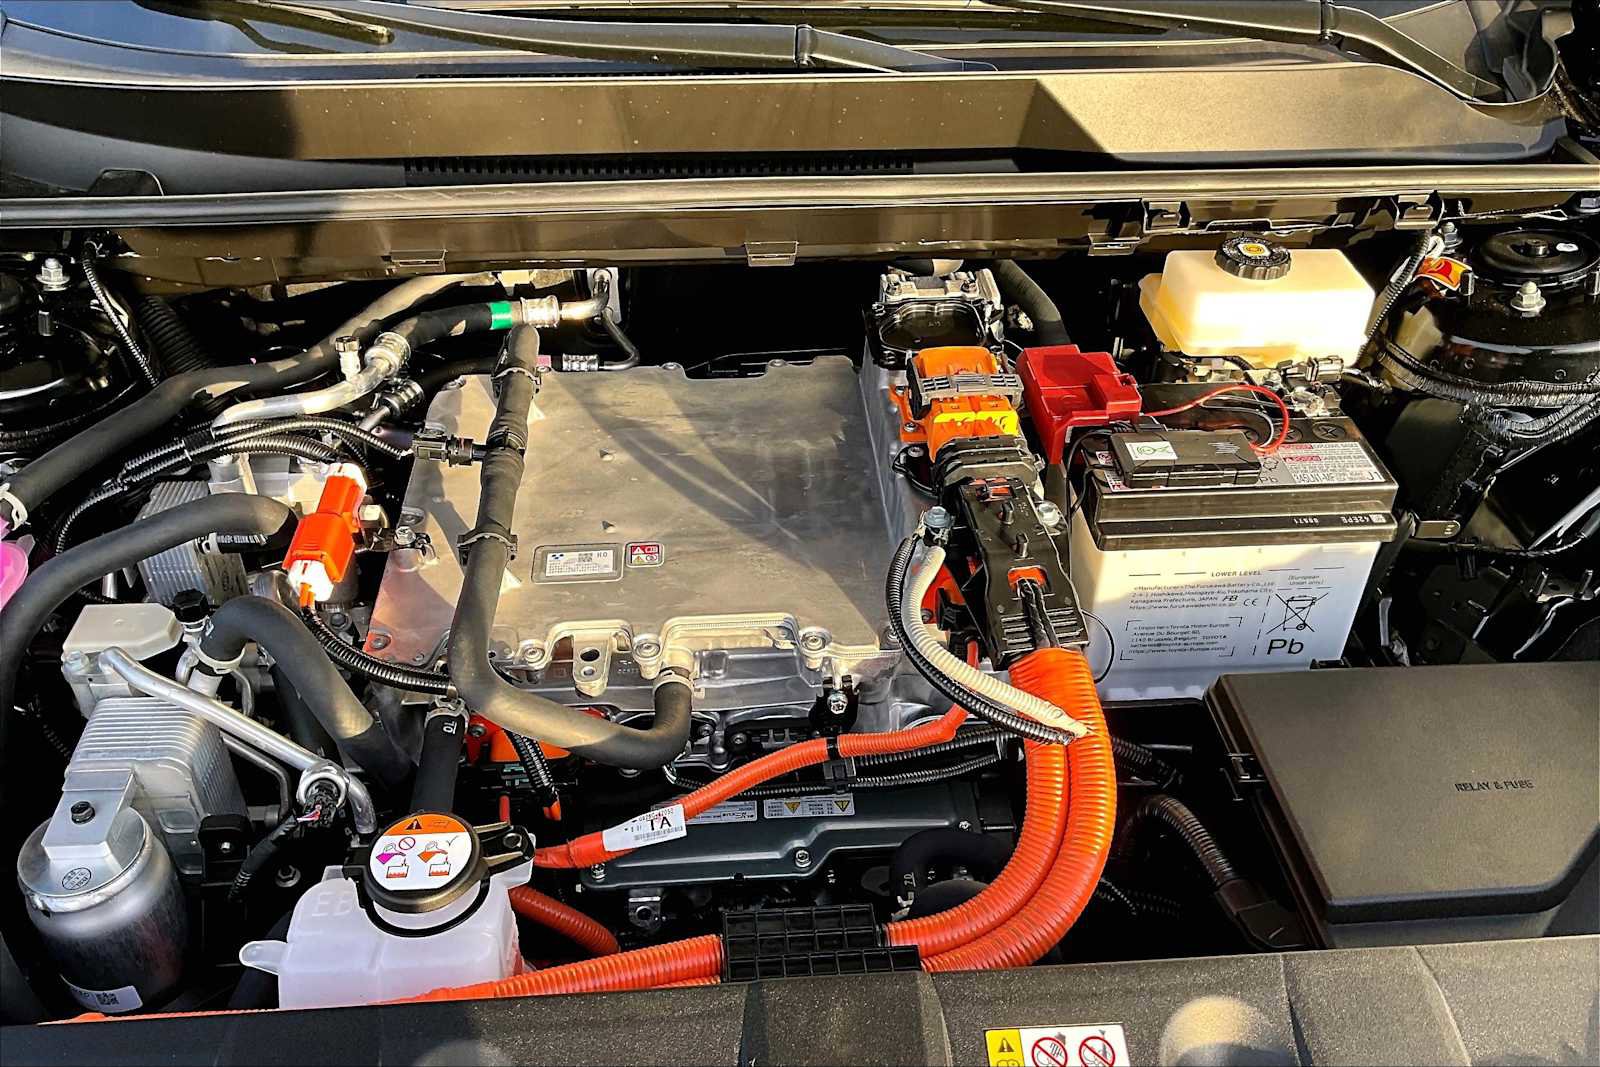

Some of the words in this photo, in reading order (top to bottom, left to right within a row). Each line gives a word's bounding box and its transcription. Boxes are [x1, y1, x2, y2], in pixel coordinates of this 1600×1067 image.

[1267, 637, 1304, 655] Pb
[1454, 781, 1491, 792] RELAY
[1493, 780, 1503, 790] &
[1503, 779, 1535, 790] FUSE
